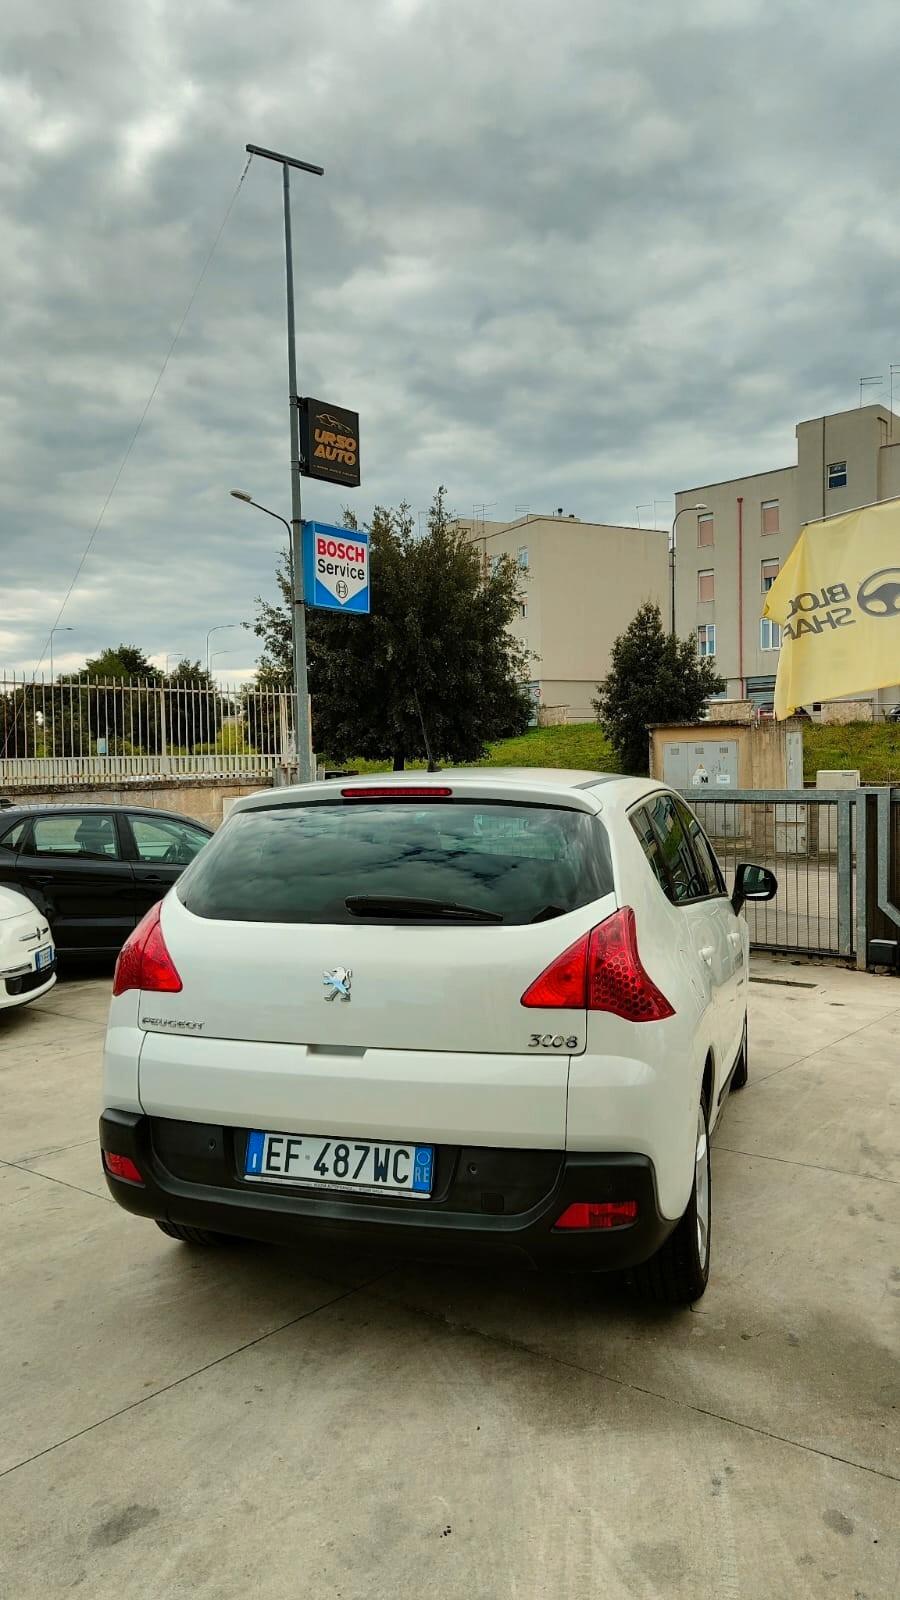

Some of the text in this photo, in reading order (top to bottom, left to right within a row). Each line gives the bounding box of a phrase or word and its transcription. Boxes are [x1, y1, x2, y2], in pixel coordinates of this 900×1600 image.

[314, 428, 357, 452] URSO
[313, 444, 356, 466] AUTO
[317, 538, 365, 563] BOSCH
[317, 558, 365, 580] Service
[142, 1016, 205, 1030] PEUGEOT
[528, 1034, 578, 1049] 3008
[265, 1137, 302, 1173] EF
[313, 1142, 410, 1184] 487WC
[415, 1166, 430, 1183] RE
